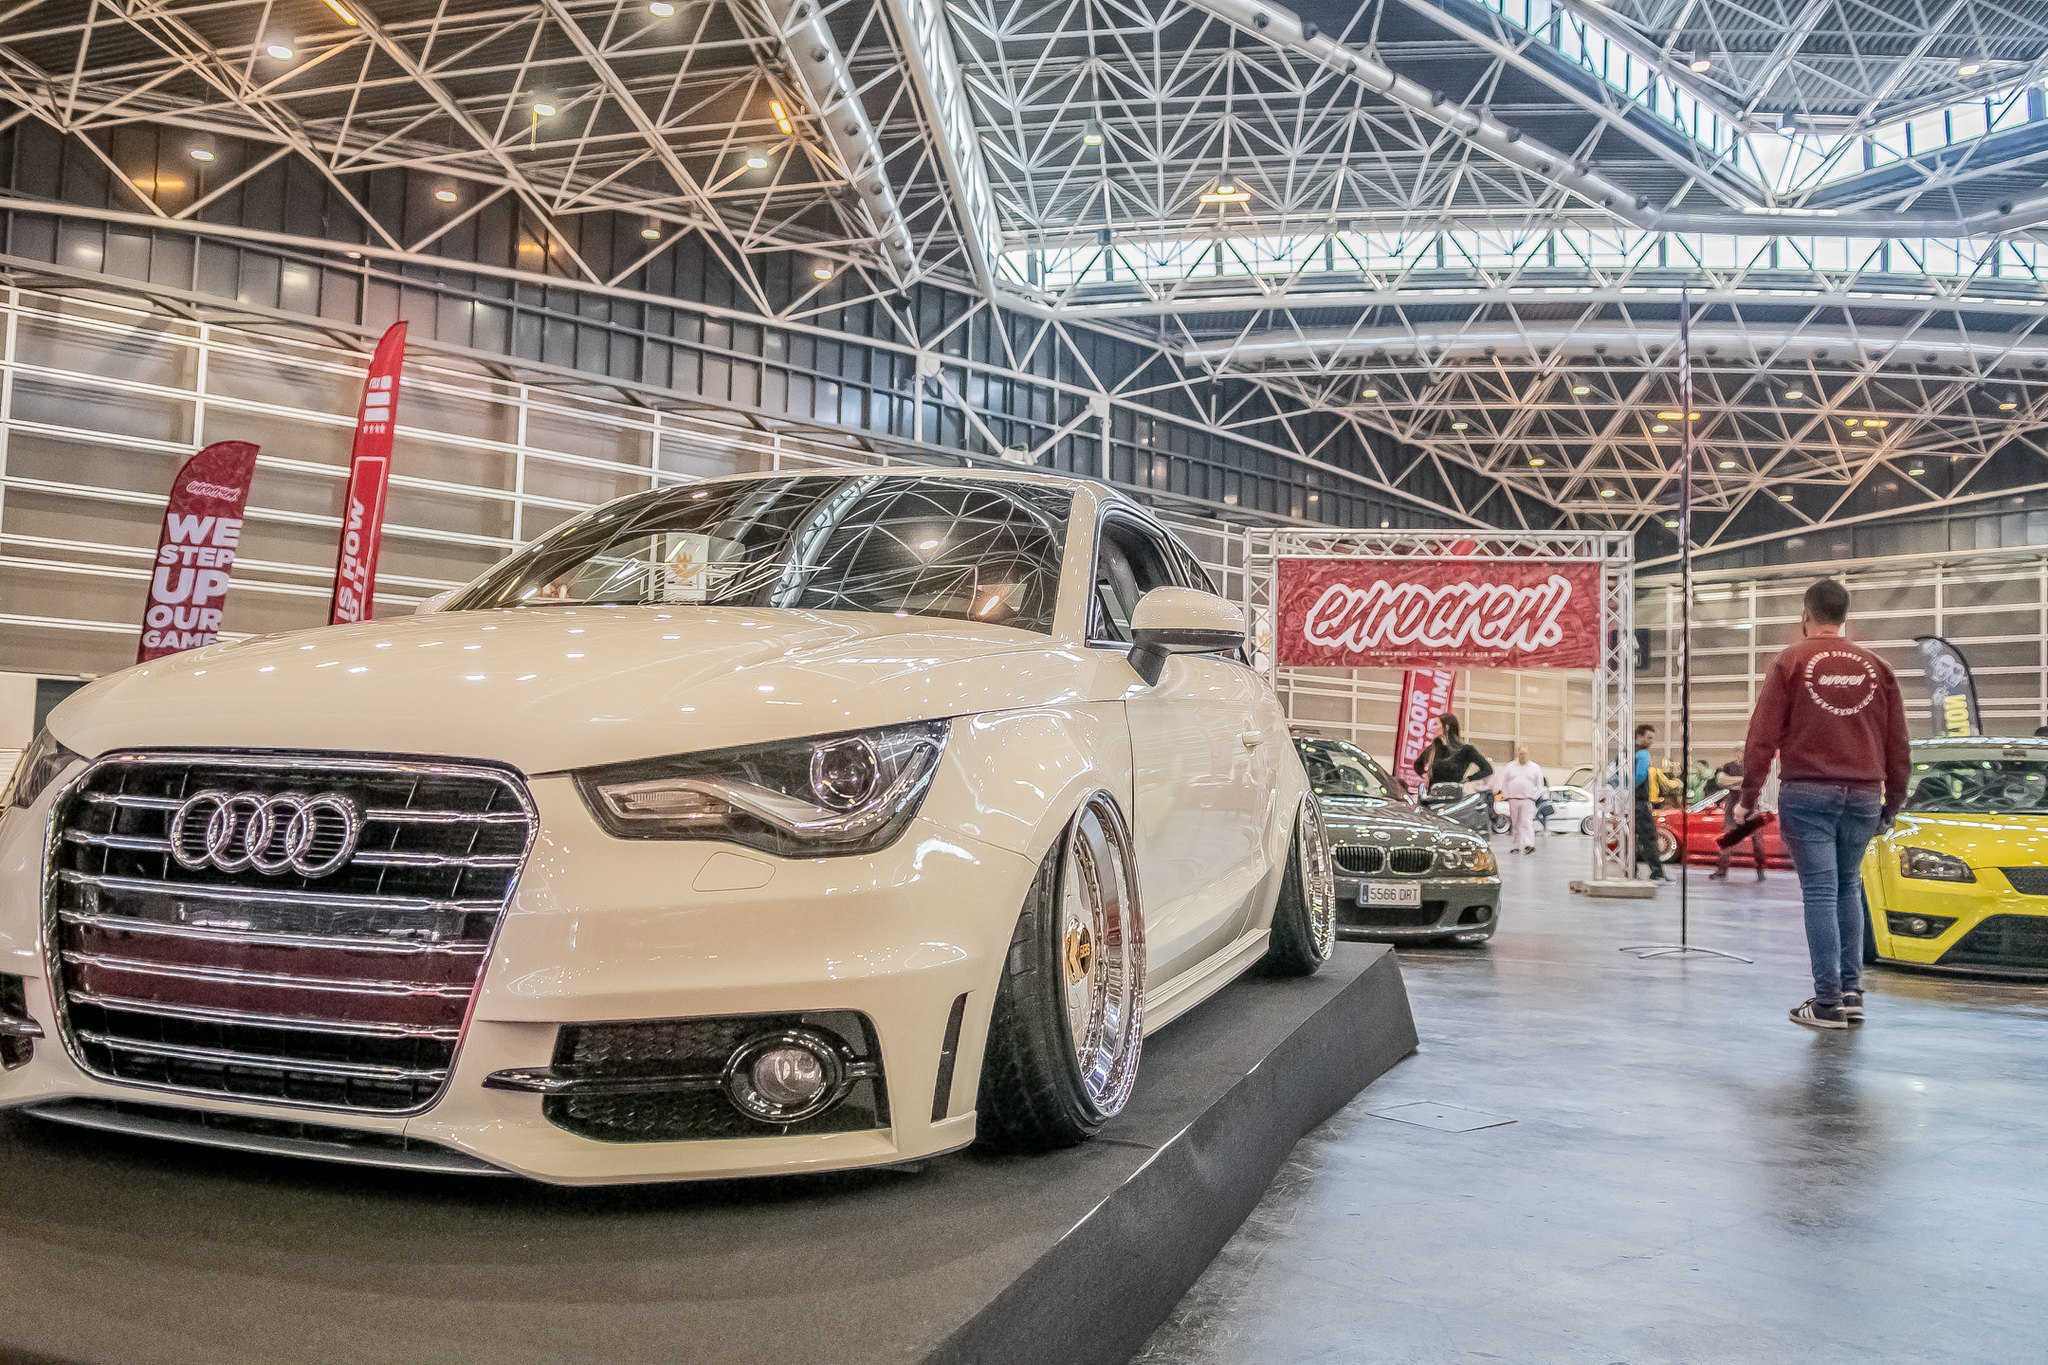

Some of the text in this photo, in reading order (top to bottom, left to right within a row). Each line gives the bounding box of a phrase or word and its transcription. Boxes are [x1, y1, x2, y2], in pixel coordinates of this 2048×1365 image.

[167, 513, 243, 547] WE
[342, 496, 365, 580] HOW
[158, 543, 236, 568] STEP
[151, 566, 230, 605] UP
[146, 604, 223, 631] OUR
[1406, 690, 1430, 760] FLOOR
[1370, 888, 1397, 901] 5566
